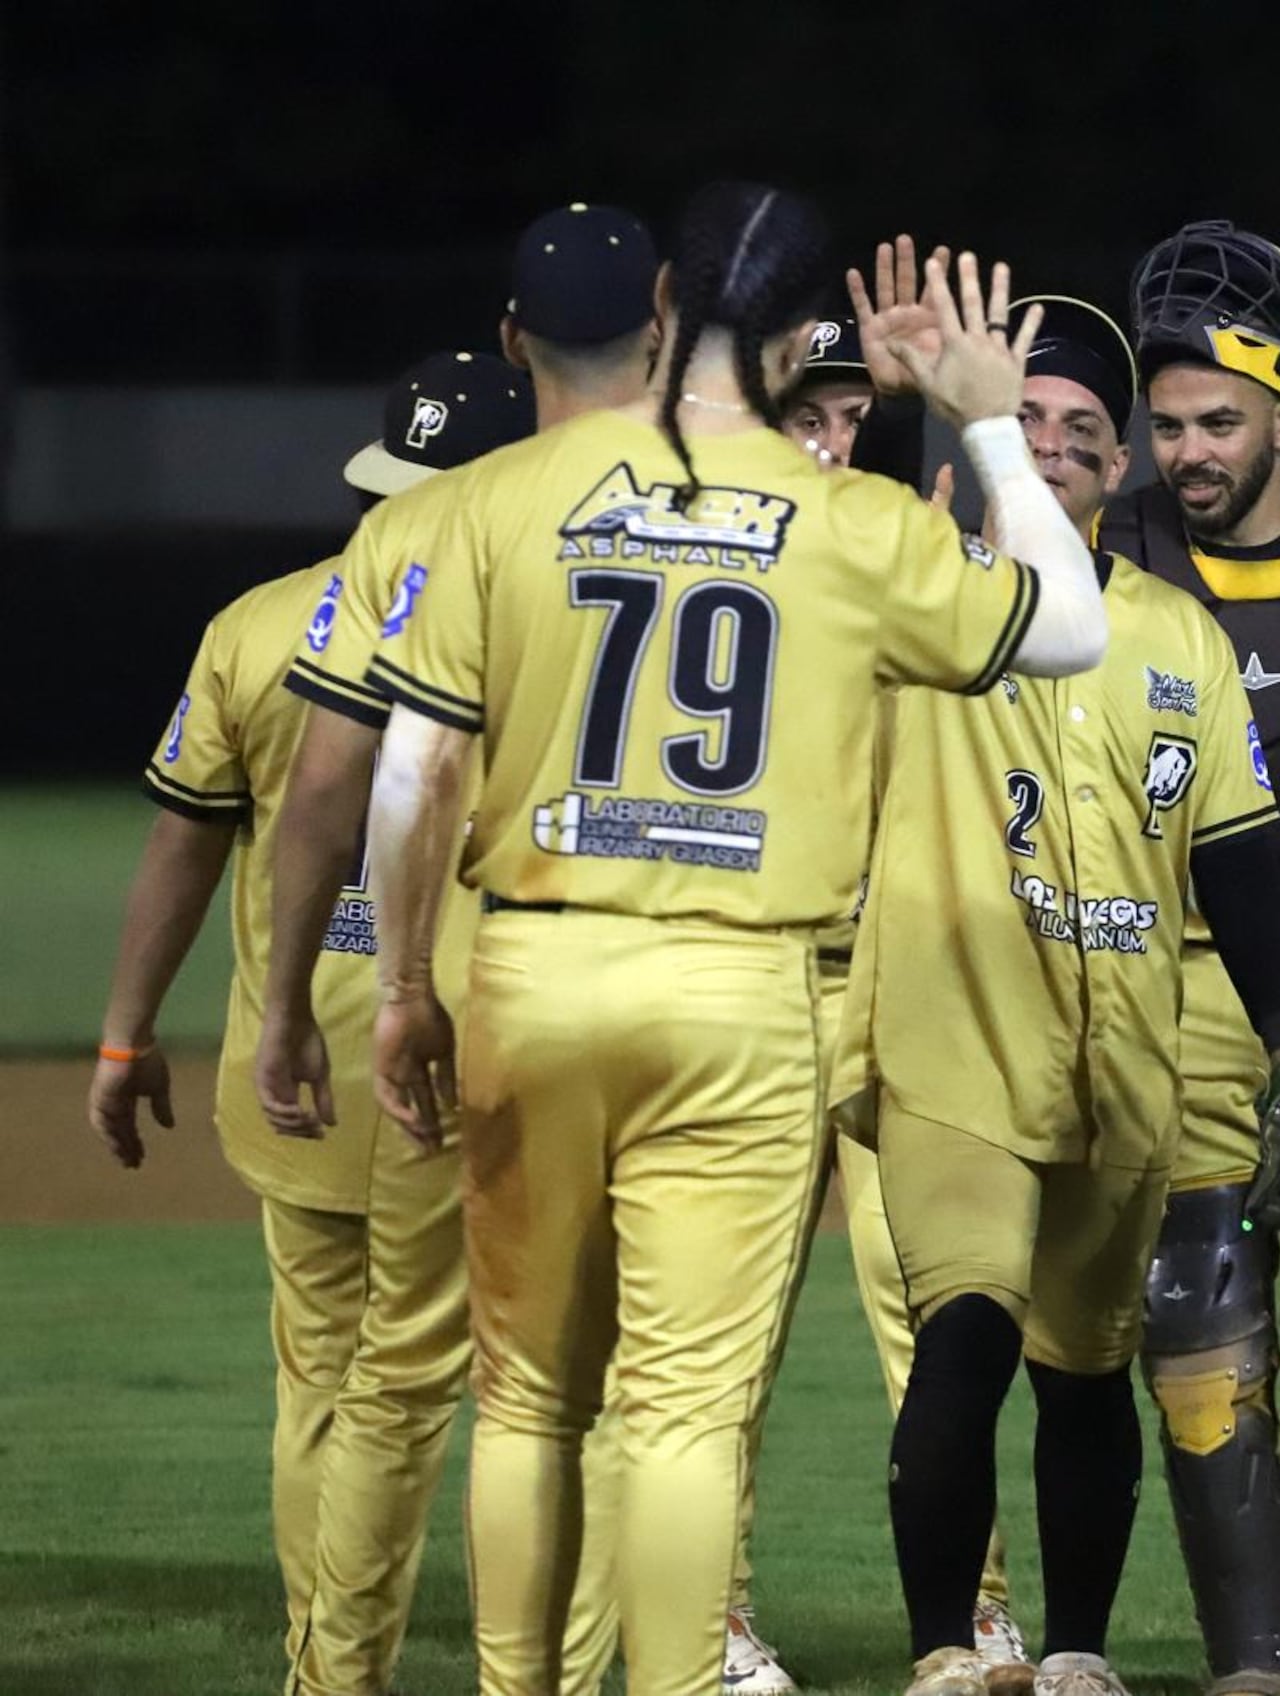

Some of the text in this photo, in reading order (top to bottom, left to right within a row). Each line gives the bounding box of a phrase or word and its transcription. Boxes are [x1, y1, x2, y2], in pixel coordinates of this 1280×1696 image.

[405, 397, 449, 449] P
[557, 535, 779, 572] ASPHALT
[568, 568, 779, 797] 79
[580, 793, 768, 836] LABORATORIO
[1004, 768, 1045, 860] 2
[1011, 866, 1058, 913] LAS
